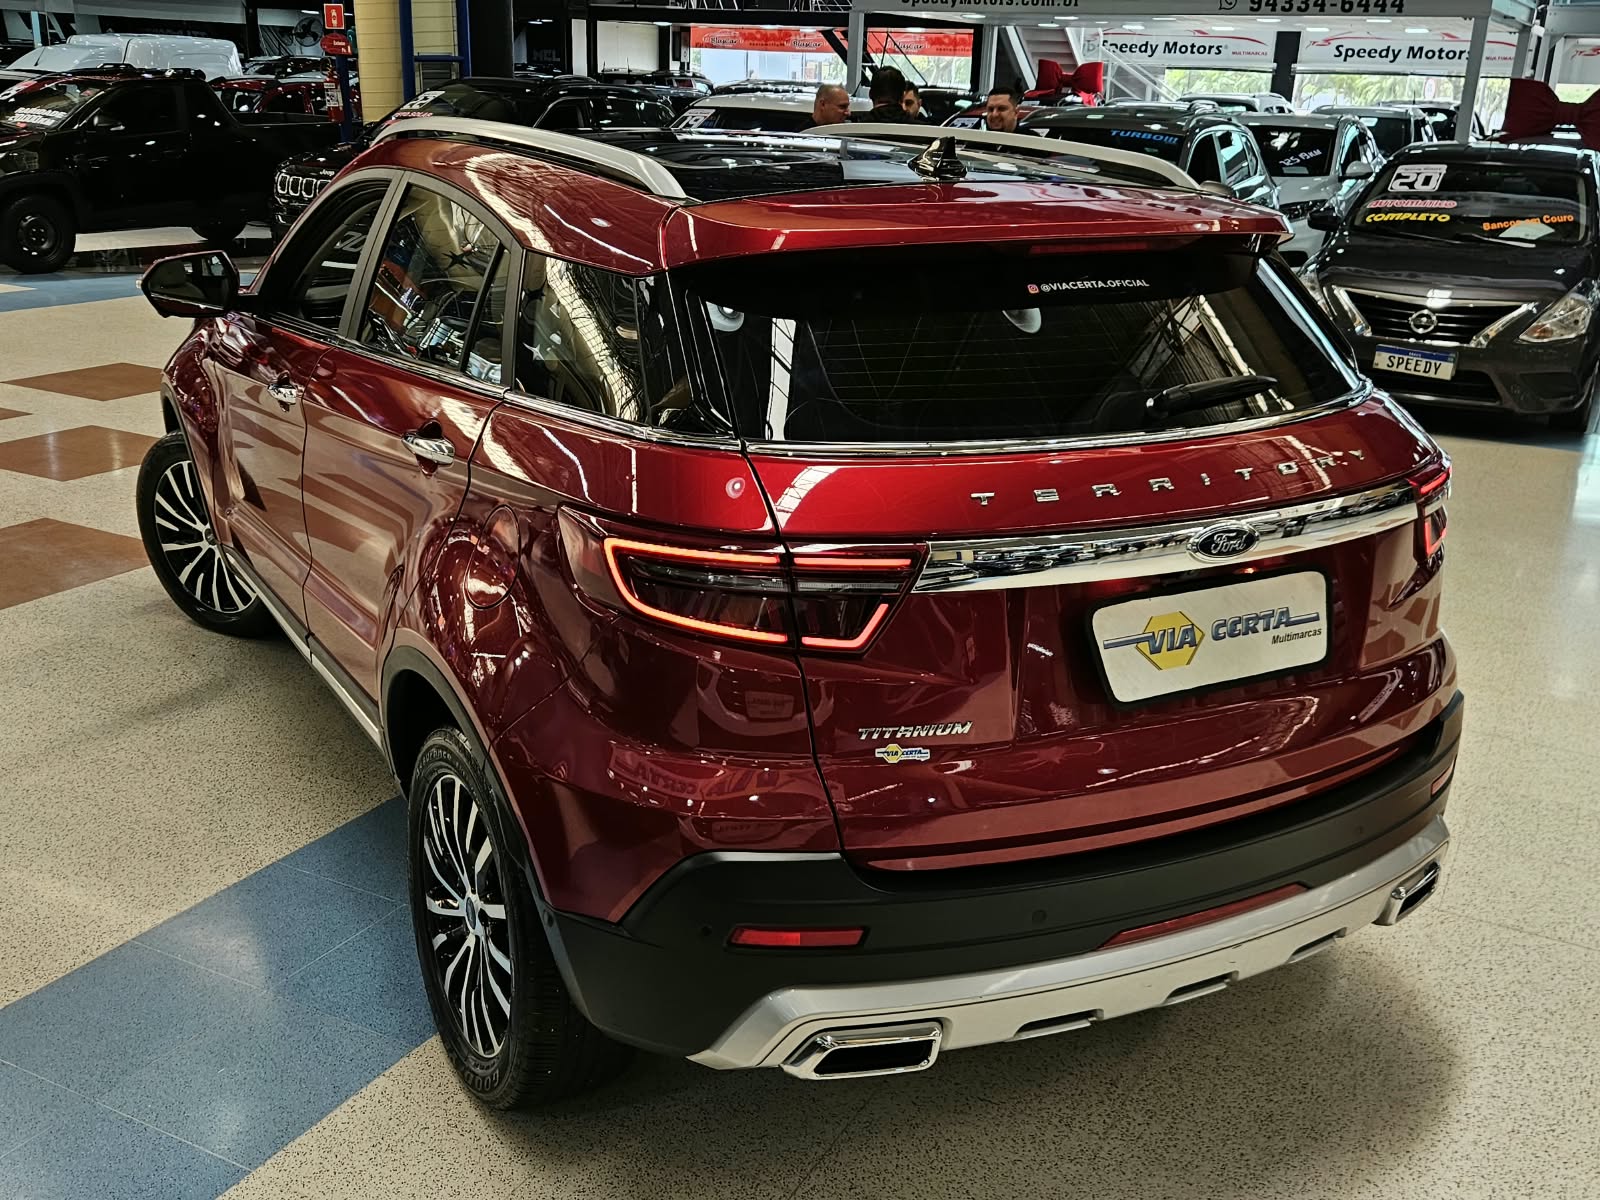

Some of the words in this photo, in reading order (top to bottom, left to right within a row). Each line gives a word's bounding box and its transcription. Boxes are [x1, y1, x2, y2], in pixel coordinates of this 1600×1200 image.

[1163, 41, 1223, 55] Motors
[1334, 44, 1402, 63] Speedy
[319, 169, 335, 177] Jeep
[1393, 172, 1440, 191] 20
[1365, 212, 1451, 223] COMPLETO
[1482, 219, 1521, 231] Bancos
[1543, 213, 1575, 225] Couro
[1040, 279, 1150, 293] @VIACERTA.OFICIAL
[1386, 355, 1442, 375] SPEEDY
[970, 449, 1366, 506] TERRITORY
[1209, 531, 1247, 555] Ford
[1148, 623, 1199, 656] VIA
[1210, 606, 1293, 642] CERTA
[1271, 627, 1323, 646] Multimarcas
[858, 721, 973, 740] TITANIUM
